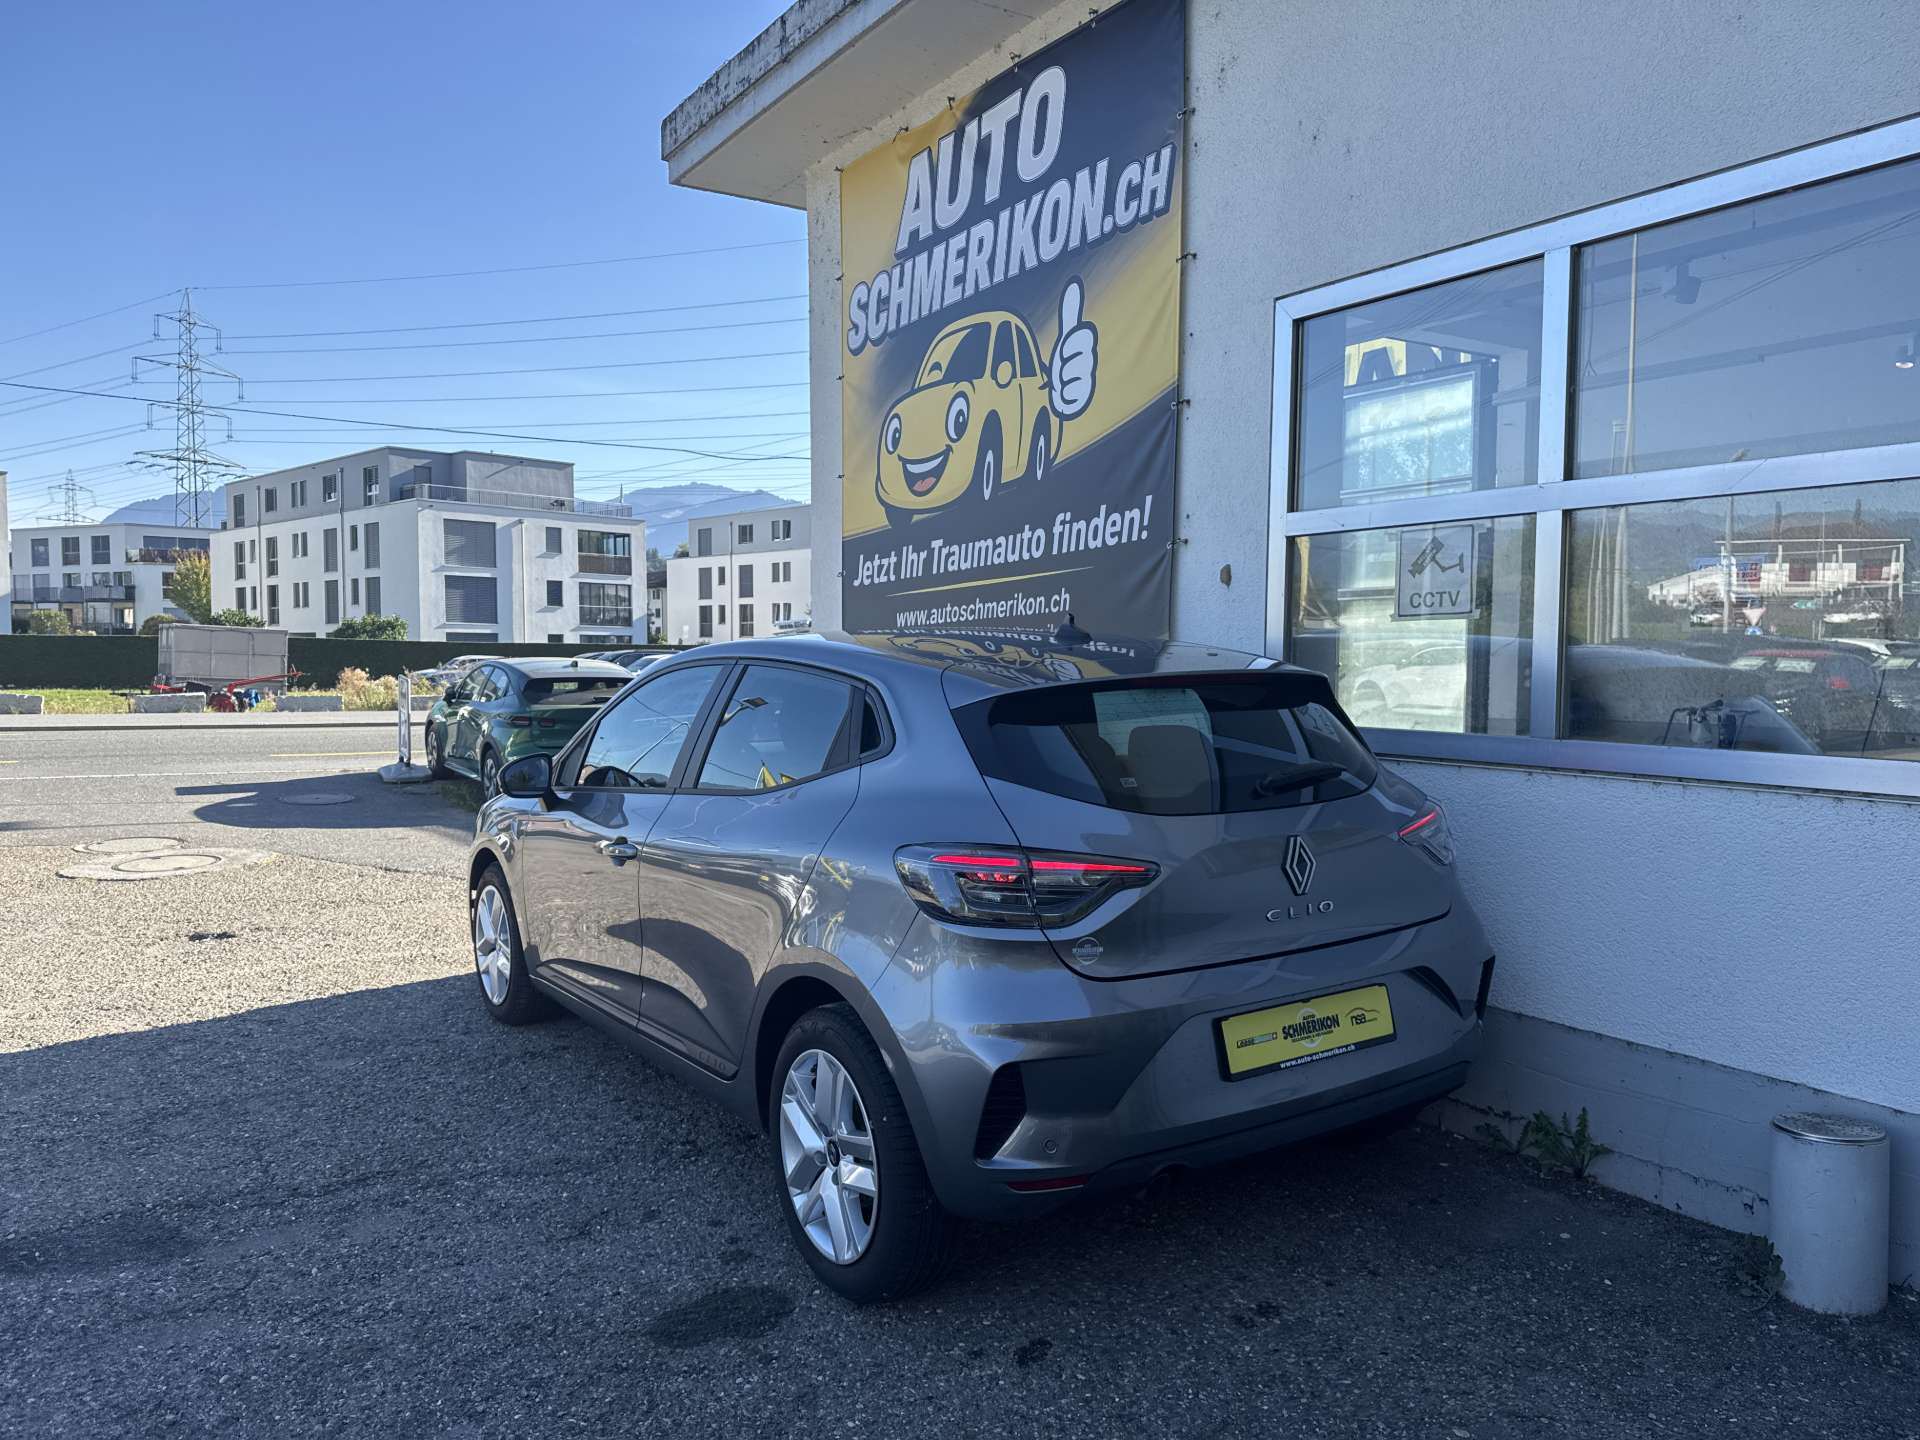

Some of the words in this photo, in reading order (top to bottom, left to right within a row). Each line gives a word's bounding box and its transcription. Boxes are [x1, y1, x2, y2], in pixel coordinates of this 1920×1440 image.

[895, 65, 1066, 254] AUTO
[848, 144, 1175, 354] SCHMERIKON.CH
[852, 554, 897, 587] Jetzt
[900, 544, 927, 579] Ihr
[930, 524, 1045, 574] Traumauto
[1052, 495, 1153, 554] finden!
[896, 588, 1071, 628] www.autoschmerikon.ch
[1409, 590, 1460, 608] CCTV
[1267, 900, 1334, 921] CLIO
[1282, 1014, 1340, 1040] SCHMERIKON
